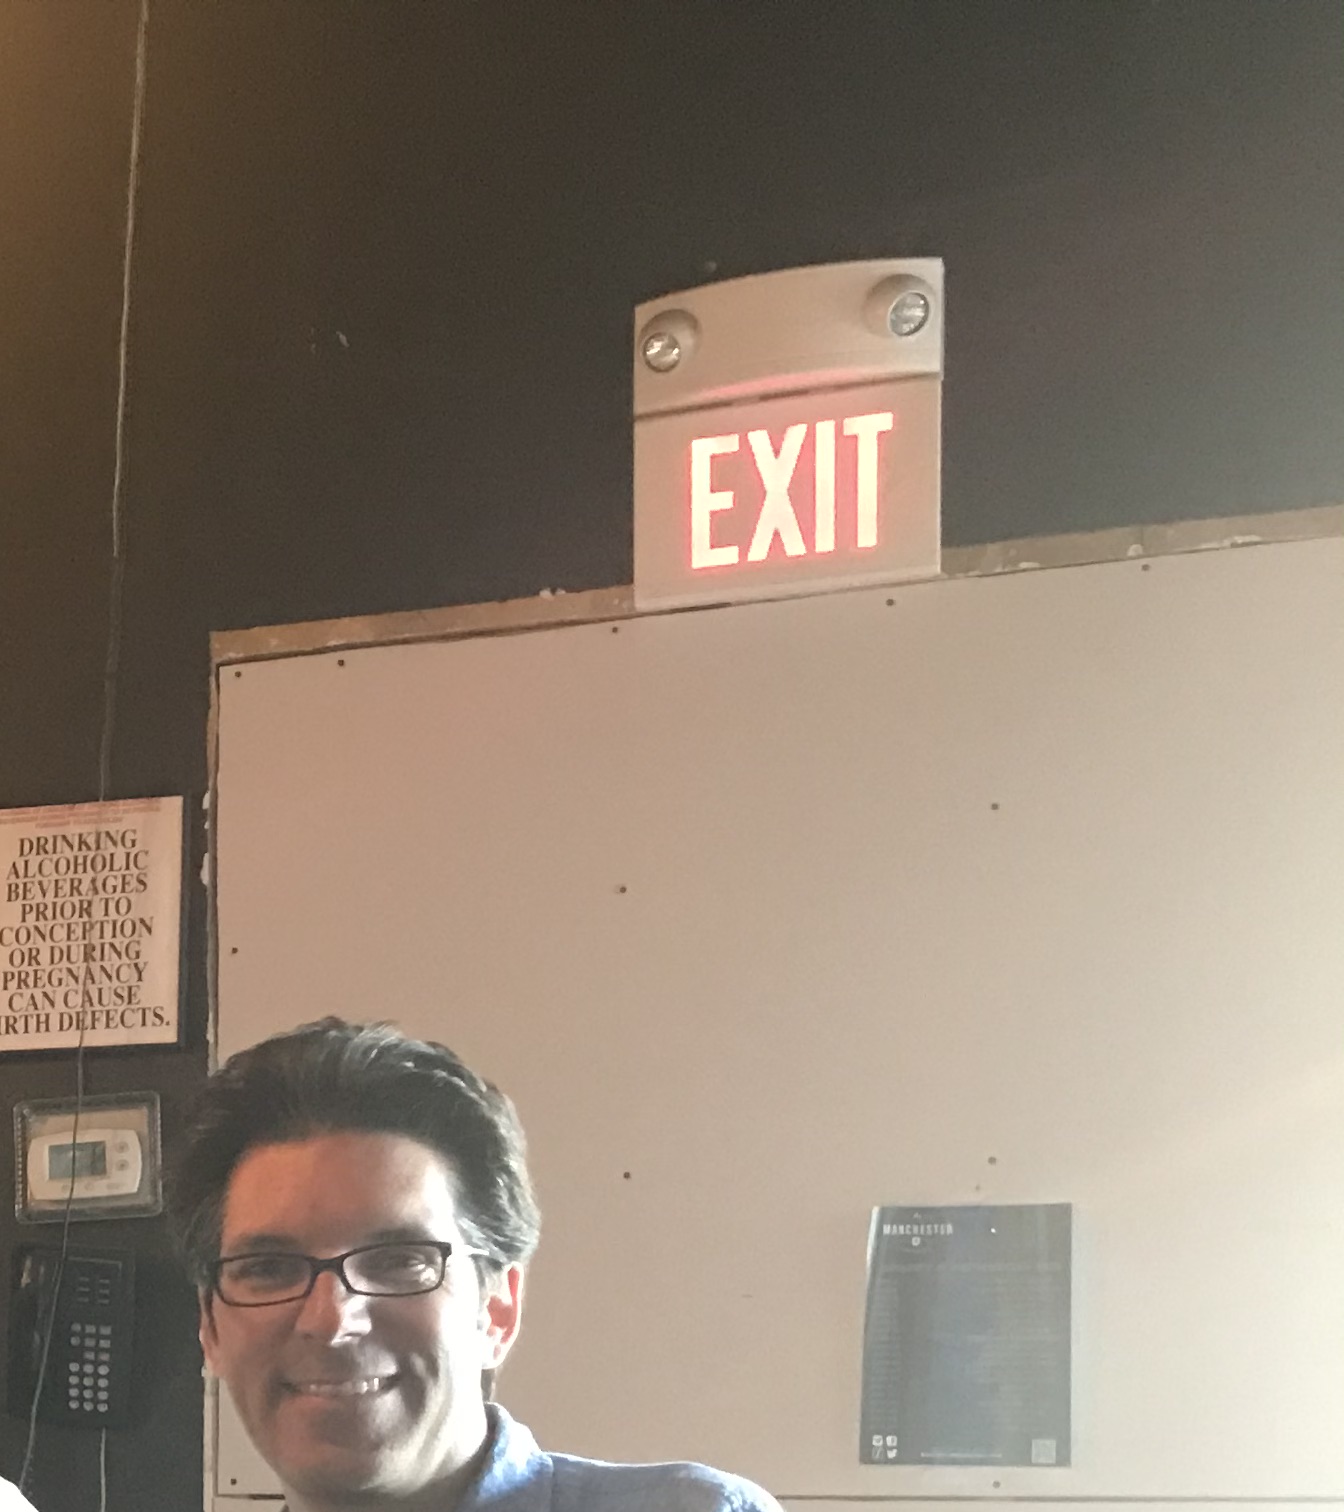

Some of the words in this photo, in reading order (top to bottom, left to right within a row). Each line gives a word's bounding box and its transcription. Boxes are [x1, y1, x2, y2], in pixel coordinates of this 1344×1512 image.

[690, 412, 894, 570] EXIT
[19, 829, 138, 857] DRINKING
[7, 850, 149, 880] ALCOHOLIC
[6, 873, 148, 902] BEVERAGES
[21, 900, 92, 922] PRIOR
[101, 897, 132, 917] TO
[0, 917, 154, 947] CONCEPTION
[8, 945, 41, 968] OR
[49, 941, 141, 964] DURING
[2, 962, 148, 991] PREGNANCY
[8, 991, 56, 1012] CAN
[63, 985, 141, 1009] CAUSE
[59, 1006, 170, 1032] DEFECTS.
[883, 1223, 953, 1235] MANCHESTER
